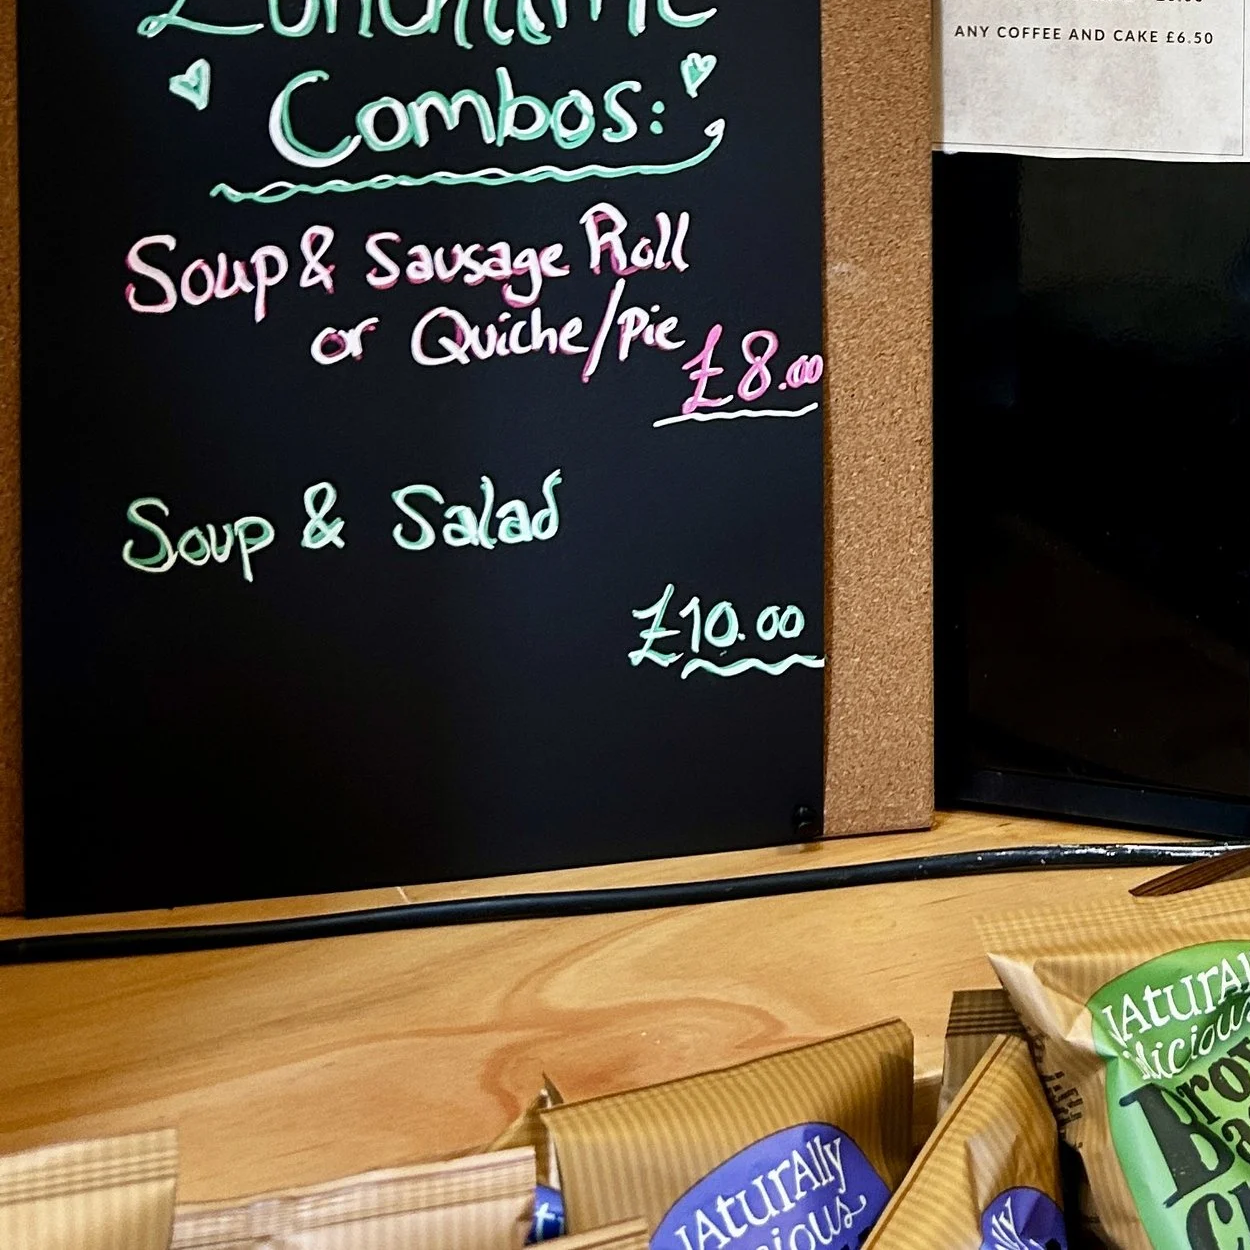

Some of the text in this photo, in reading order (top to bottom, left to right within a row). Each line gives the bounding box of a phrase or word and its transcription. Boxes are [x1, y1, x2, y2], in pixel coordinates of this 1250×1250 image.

[954, 25, 1214, 45] ANY COFFEE AND CAKE £6.50
[269, 66, 665, 168] Combos:
[126, 202, 689, 323] Soup & Sausage Roll
[311, 317, 378, 366] or
[681, 324, 824, 414] £8.00
[122, 468, 563, 583] Soup & Salad
[628, 583, 805, 667] £10.00
